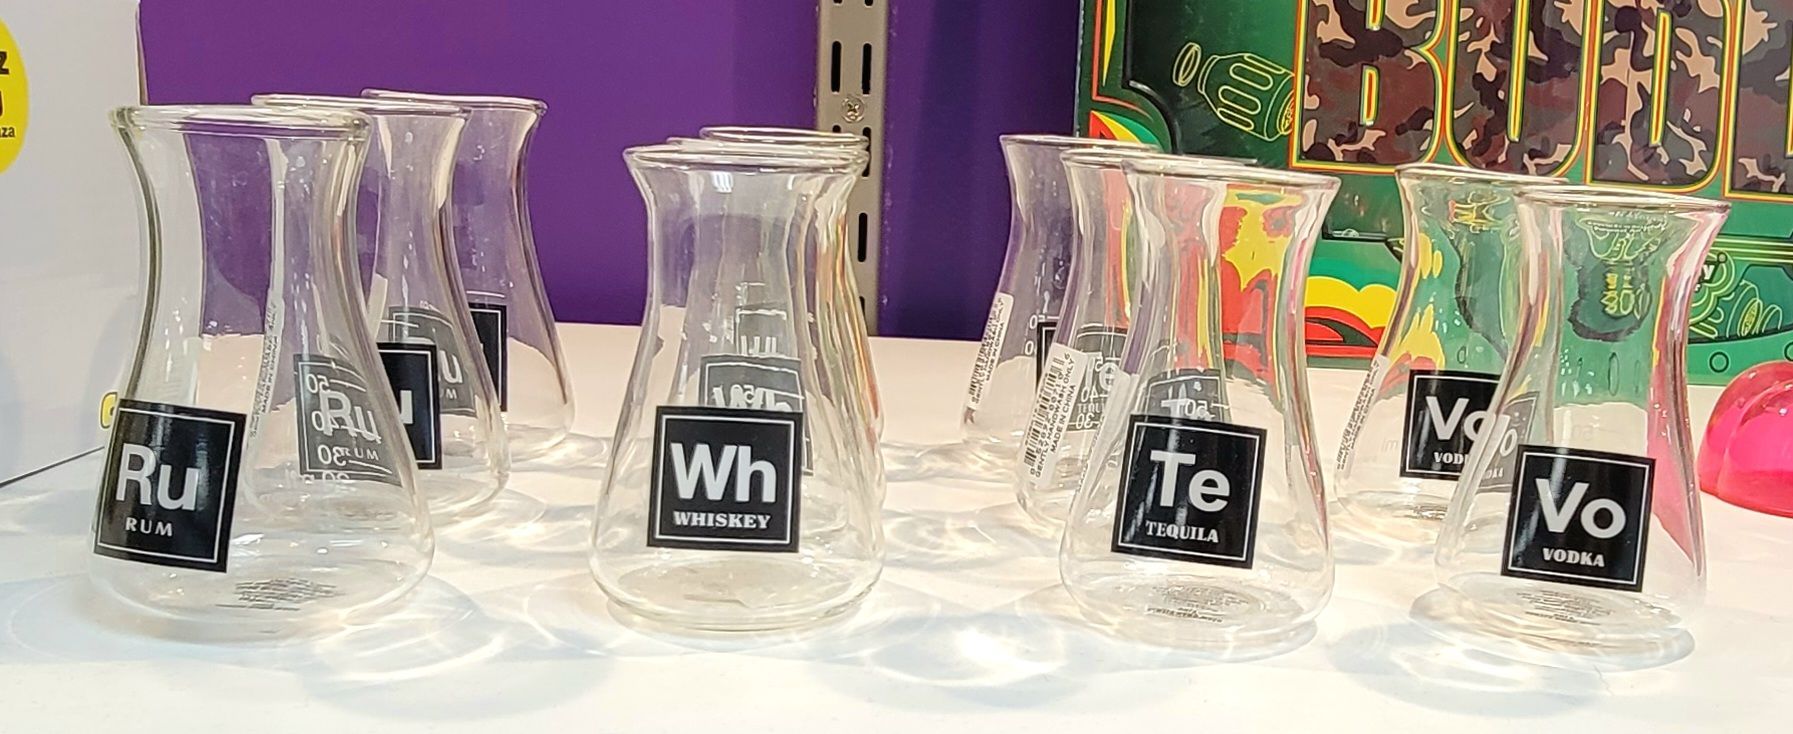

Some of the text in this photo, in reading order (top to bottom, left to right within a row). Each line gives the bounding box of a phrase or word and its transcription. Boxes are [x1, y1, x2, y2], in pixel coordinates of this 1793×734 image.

[1061, 358, 1076, 384] ONLY
[1049, 384, 1077, 453] MADE IN CHINA
[115, 442, 200, 511] Ru
[670, 441, 777, 504] Wh
[1150, 450, 1231, 513] Te
[125, 516, 173, 537] RUM
[673, 510, 771, 530] WHISKEY
[1535, 477, 1627, 539] Vo
[1146, 519, 1220, 544] TEQUILA
[1542, 547, 1606, 568] VODKA
